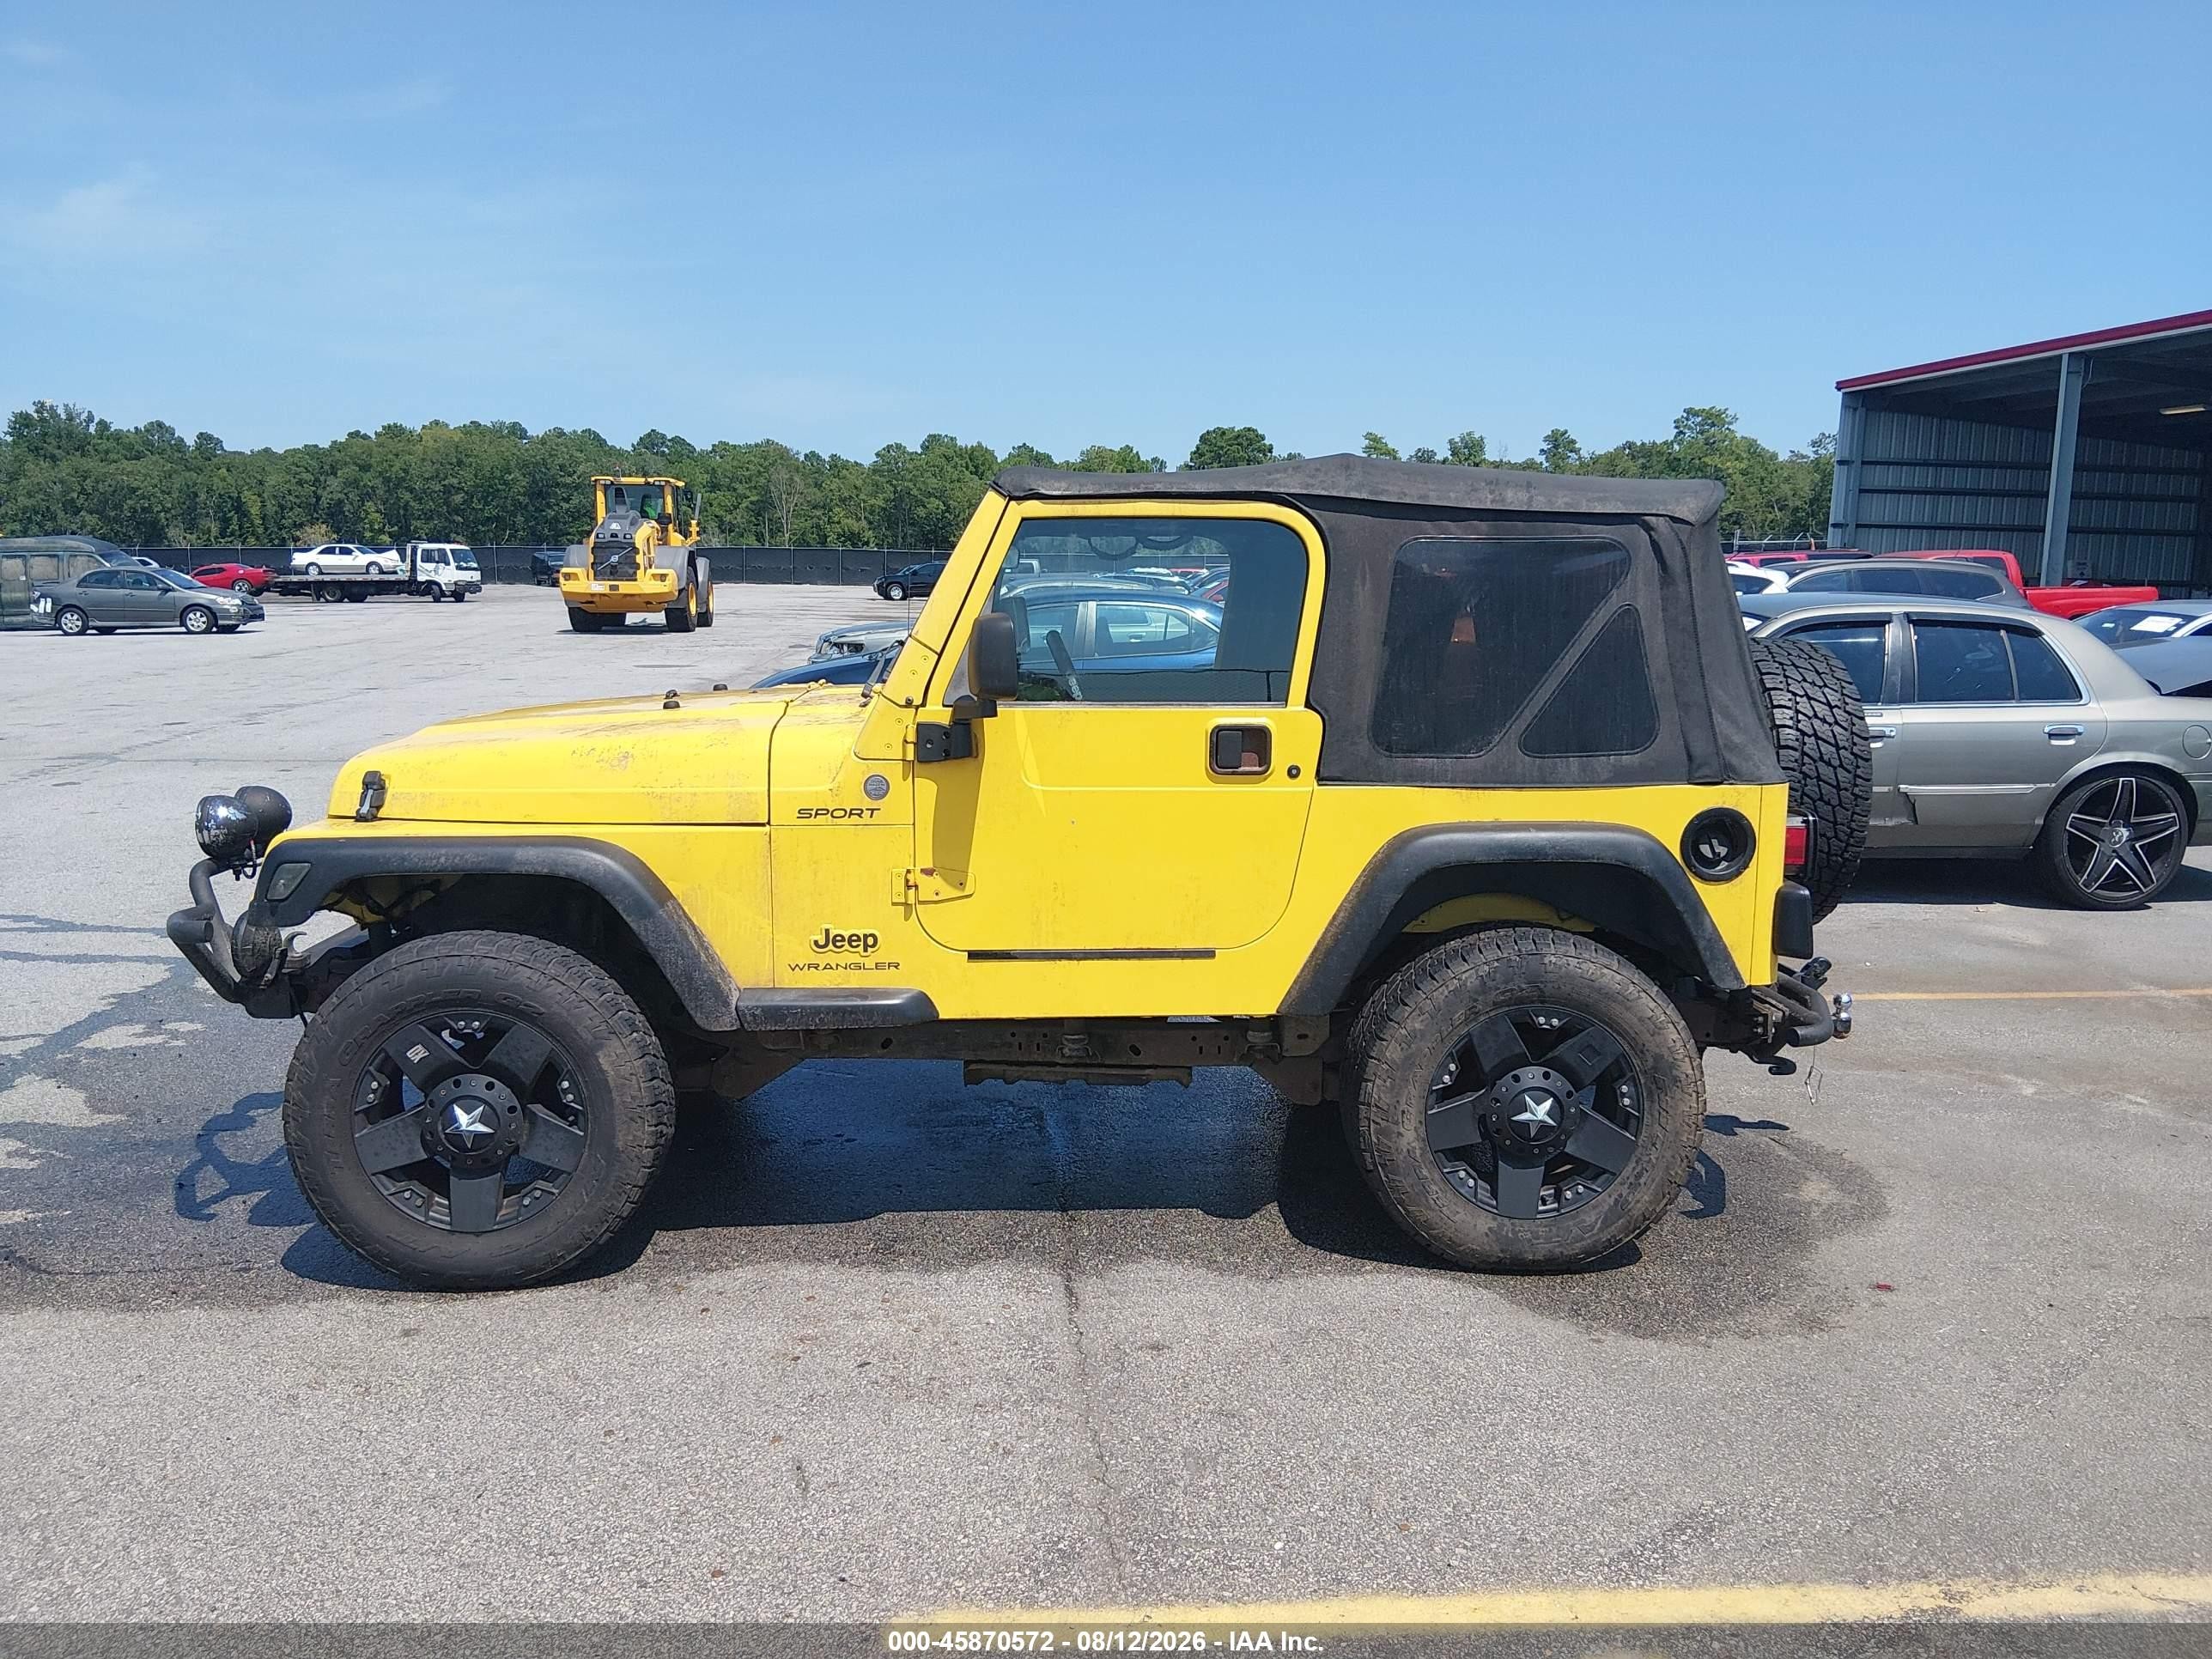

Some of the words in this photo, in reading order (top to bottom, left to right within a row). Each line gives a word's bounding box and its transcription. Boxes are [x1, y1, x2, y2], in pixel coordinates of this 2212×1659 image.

[796, 808, 881, 819] SPORT
[813, 927, 878, 952] Jeep
[787, 962, 901, 972] WRANGLER
